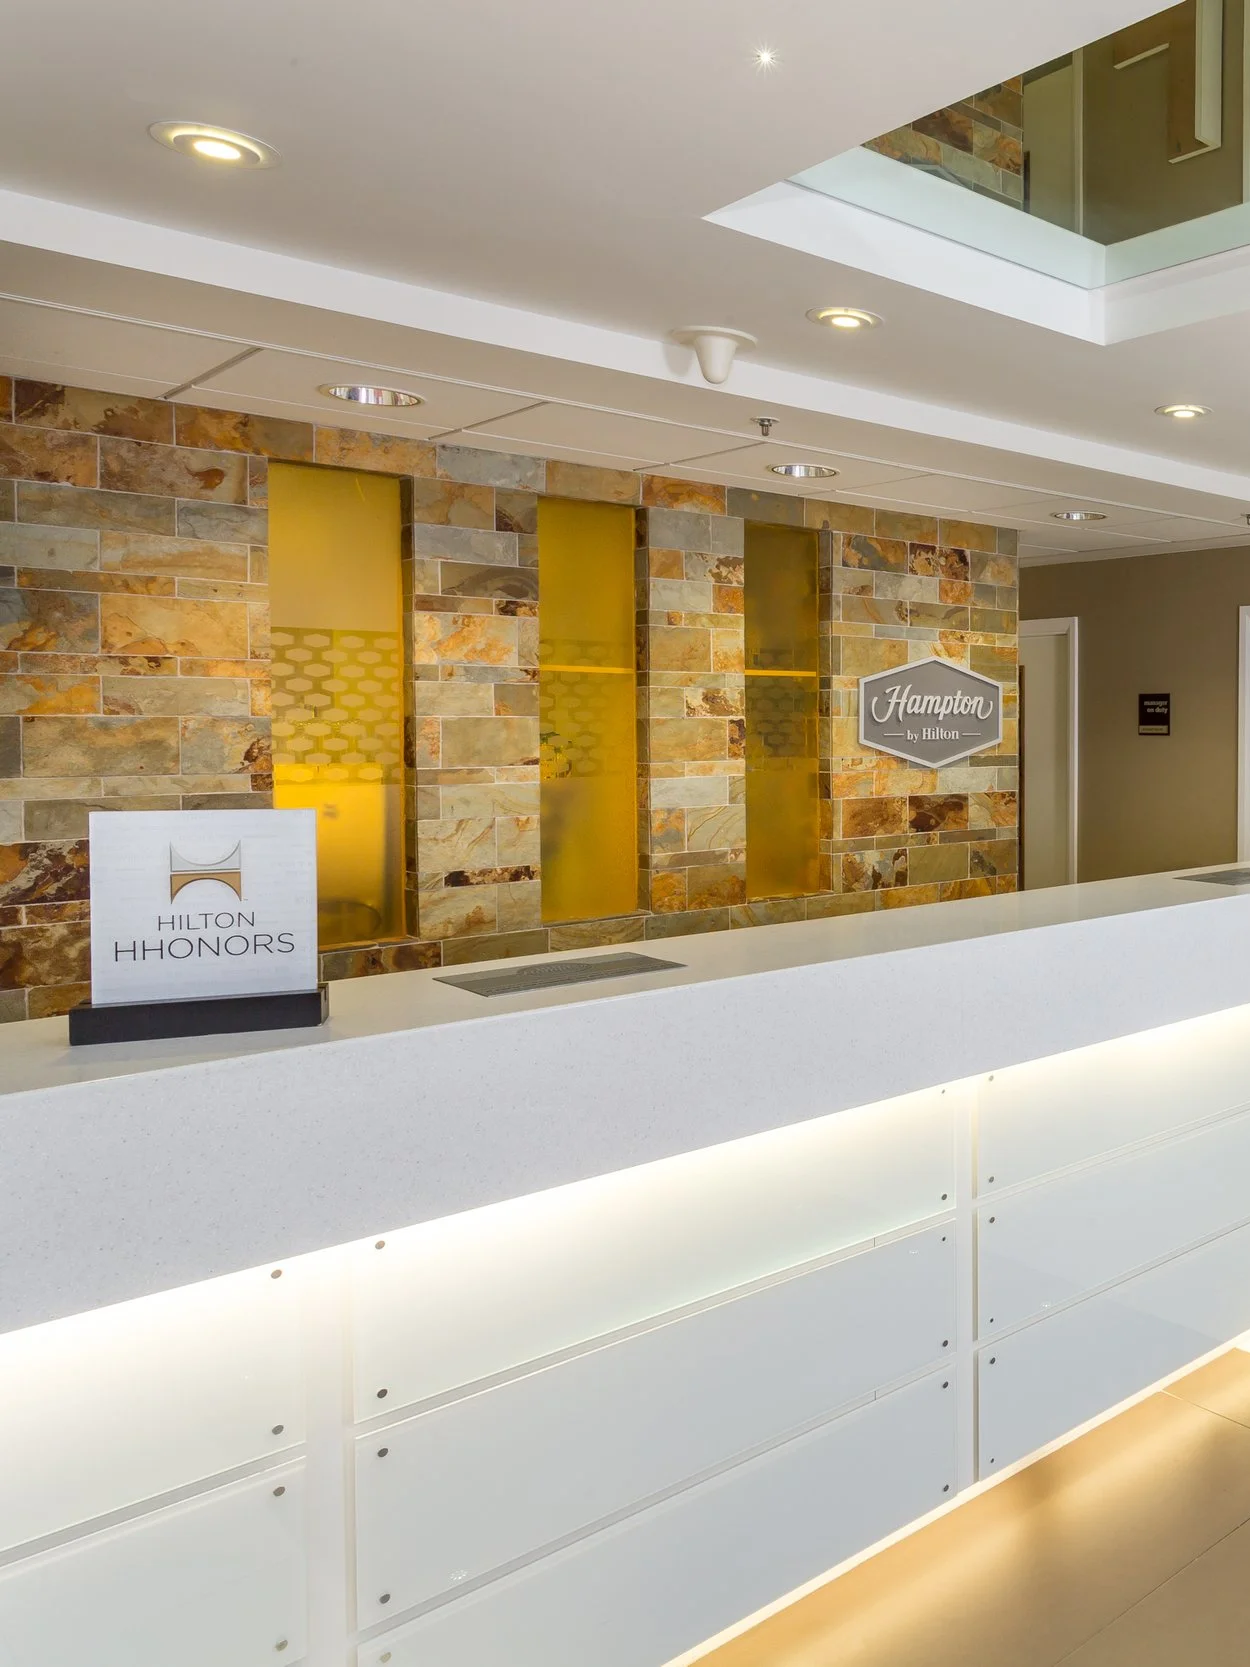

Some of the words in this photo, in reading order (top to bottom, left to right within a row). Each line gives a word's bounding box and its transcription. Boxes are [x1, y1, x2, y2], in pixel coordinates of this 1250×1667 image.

[871, 684, 993, 723] Hampton
[906, 730, 919, 743] by
[922, 727, 960, 740] Hilton
[158, 911, 255, 931] HILTON
[114, 932, 296, 962] HHONORS
